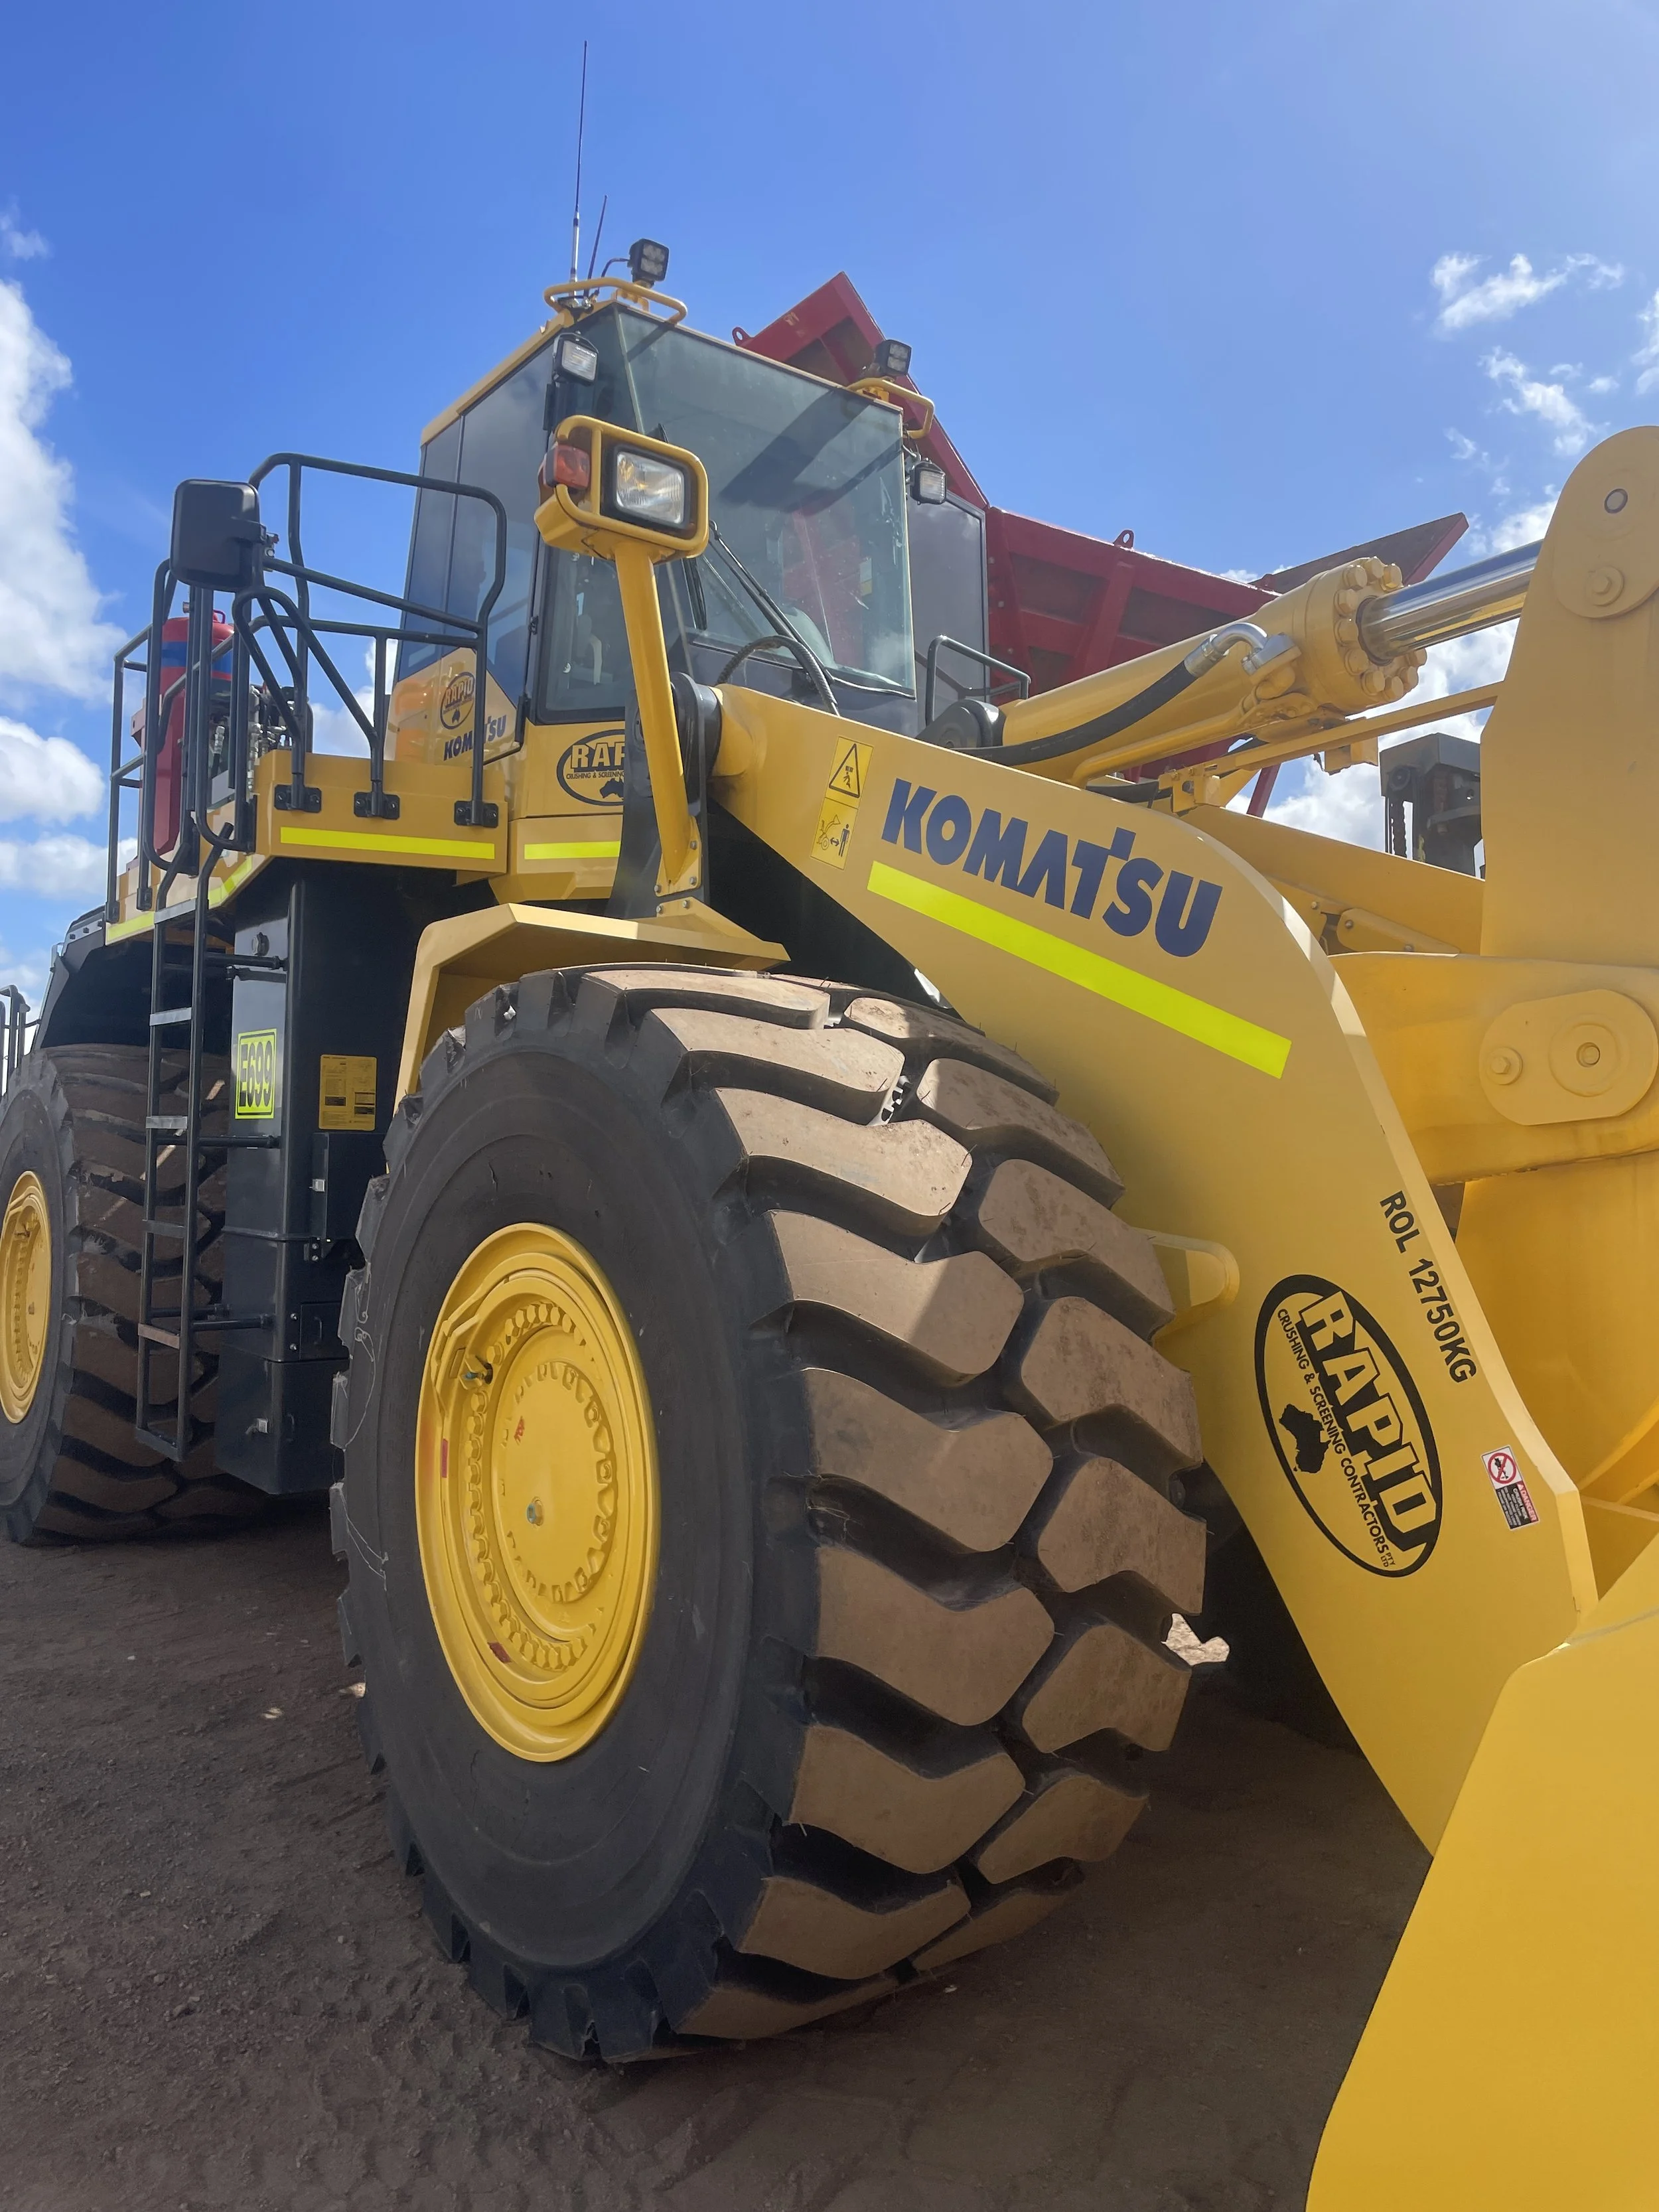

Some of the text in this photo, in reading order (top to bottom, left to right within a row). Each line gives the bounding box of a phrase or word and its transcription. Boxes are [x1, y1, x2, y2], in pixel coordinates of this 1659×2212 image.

[445, 676, 474, 709] RAPID
[443, 714, 507, 761] KOMTSU
[882, 778, 1222, 958] KOMATSU
[239, 1041, 273, 1108] E699
[1380, 1190, 1420, 1254] ROL
[1409, 1258, 1477, 1383] 12750KG
[1277, 1308, 1390, 1554] CRUSHING & SCREENING CONTRACTORS
[1299, 1290, 1437, 1534] RAPID
[1521, 1489, 1538, 1522] DANGER
[1380, 1555, 1390, 1568] LTD
[1385, 1552, 1396, 1566] PTY
